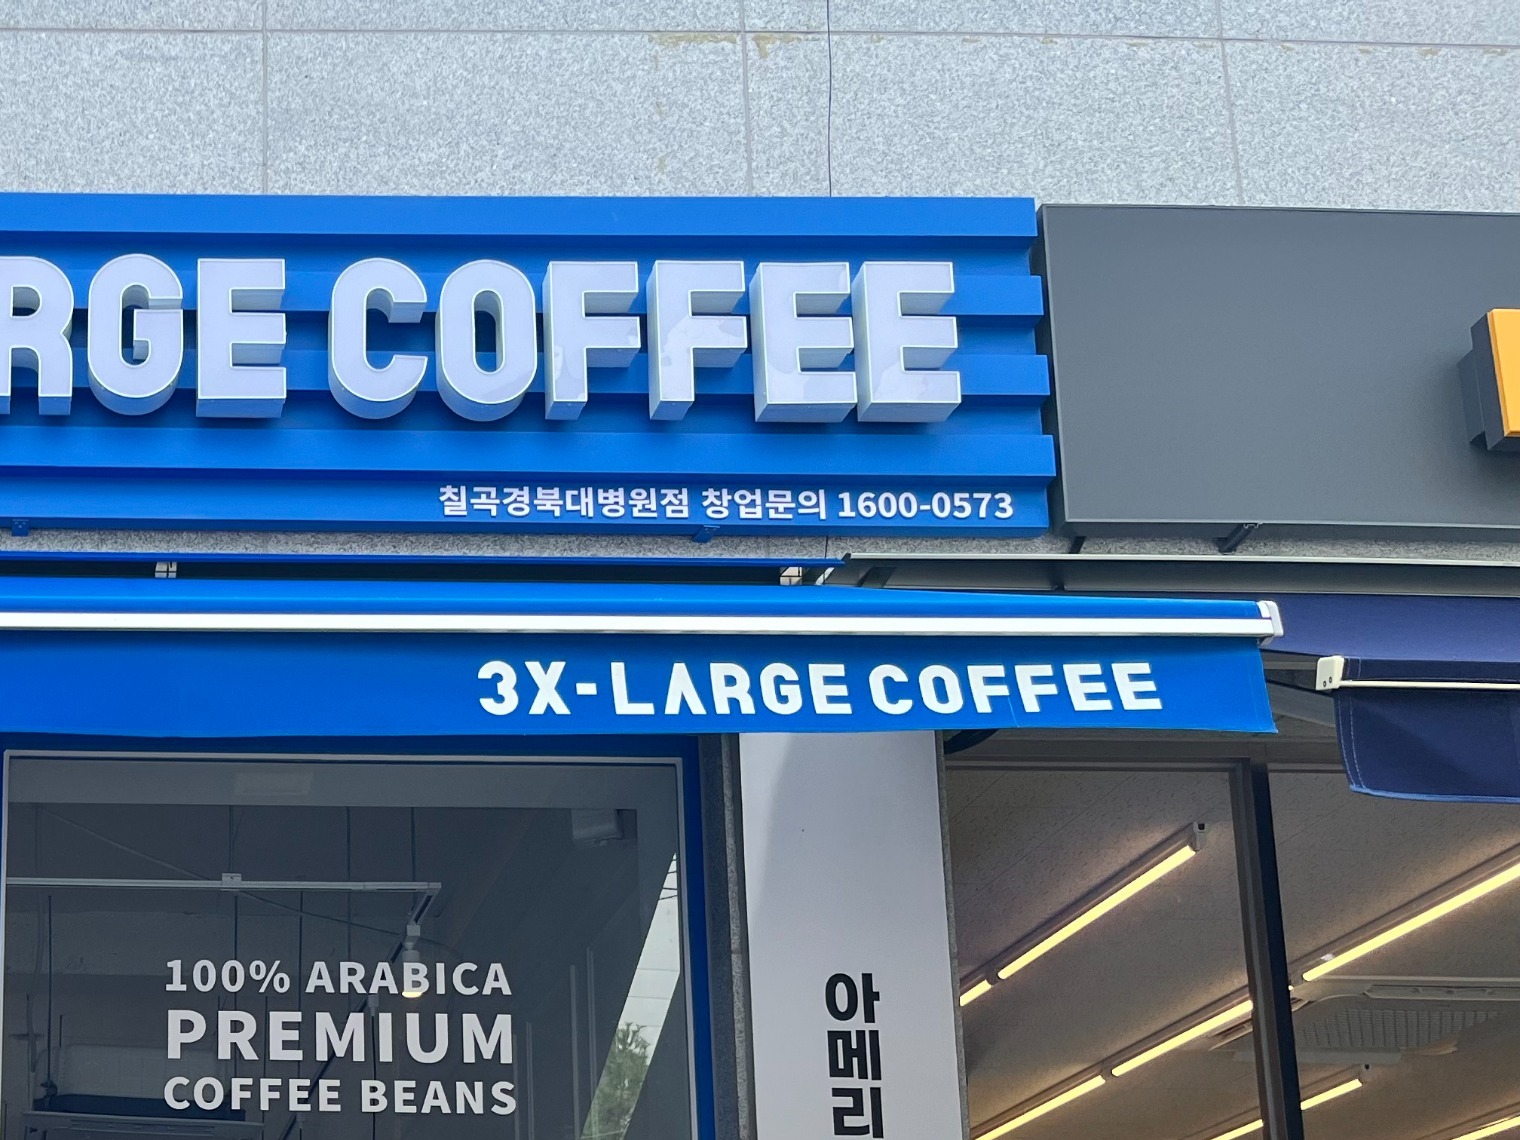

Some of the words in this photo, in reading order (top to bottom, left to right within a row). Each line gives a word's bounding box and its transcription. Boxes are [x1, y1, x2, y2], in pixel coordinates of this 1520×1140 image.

[327, 257, 962, 421] COFFEE
[439, 485, 689, 518] 칠곡경북대병원점
[702, 487, 827, 520] 창업문의
[838, 491, 1015, 520] 1600-0573
[478, 660, 853, 716] 3X-LARGE
[869, 662, 1164, 716] COFFEE
[165, 959, 291, 994] 100%
[305, 960, 512, 996] ARABICA
[167, 1009, 513, 1065] PREMIUM
[163, 1076, 341, 1112] COFFEE
[361, 1080, 517, 1116] BEANS
